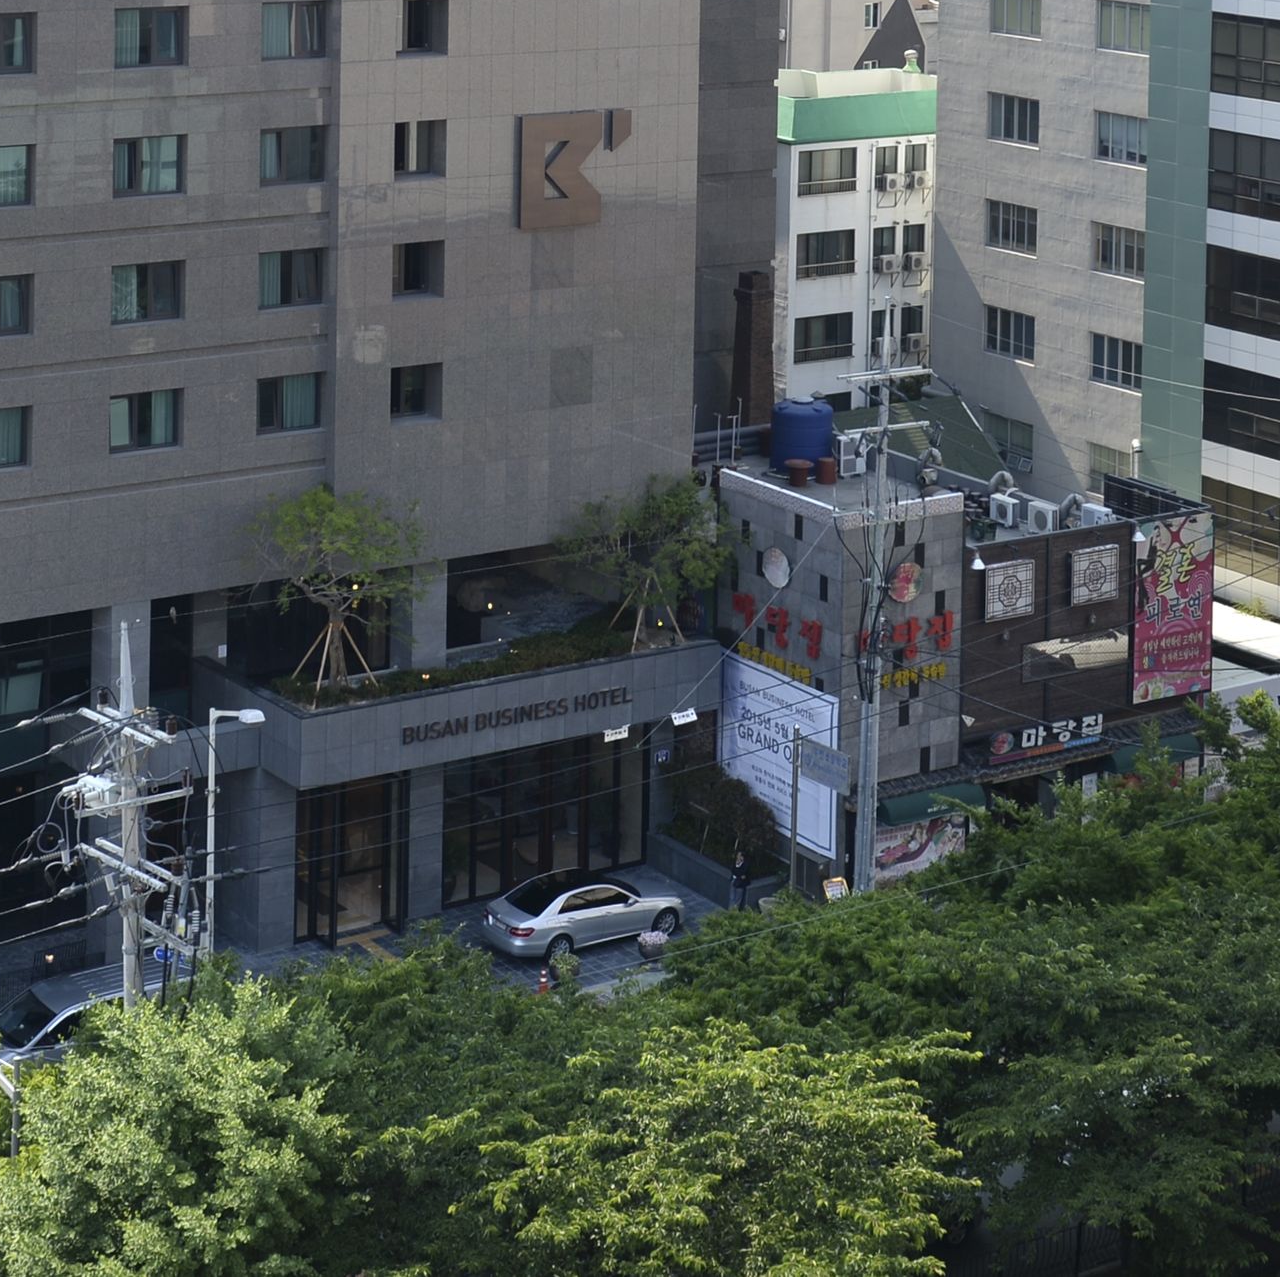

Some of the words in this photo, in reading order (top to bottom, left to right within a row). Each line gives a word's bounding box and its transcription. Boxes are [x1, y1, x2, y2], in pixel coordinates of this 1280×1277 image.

[1156, 542, 1197, 595] 결혼
[402, 716, 469, 746] BUSAN
[475, 697, 569, 732] BUSINESS
[573, 687, 633, 713] HOTEL
[762, 690, 794, 713] BUSINESS
[795, 706, 816, 723] HOTEL
[737, 723, 780, 755] GRAND
[1021, 713, 1104, 749] 마당집
